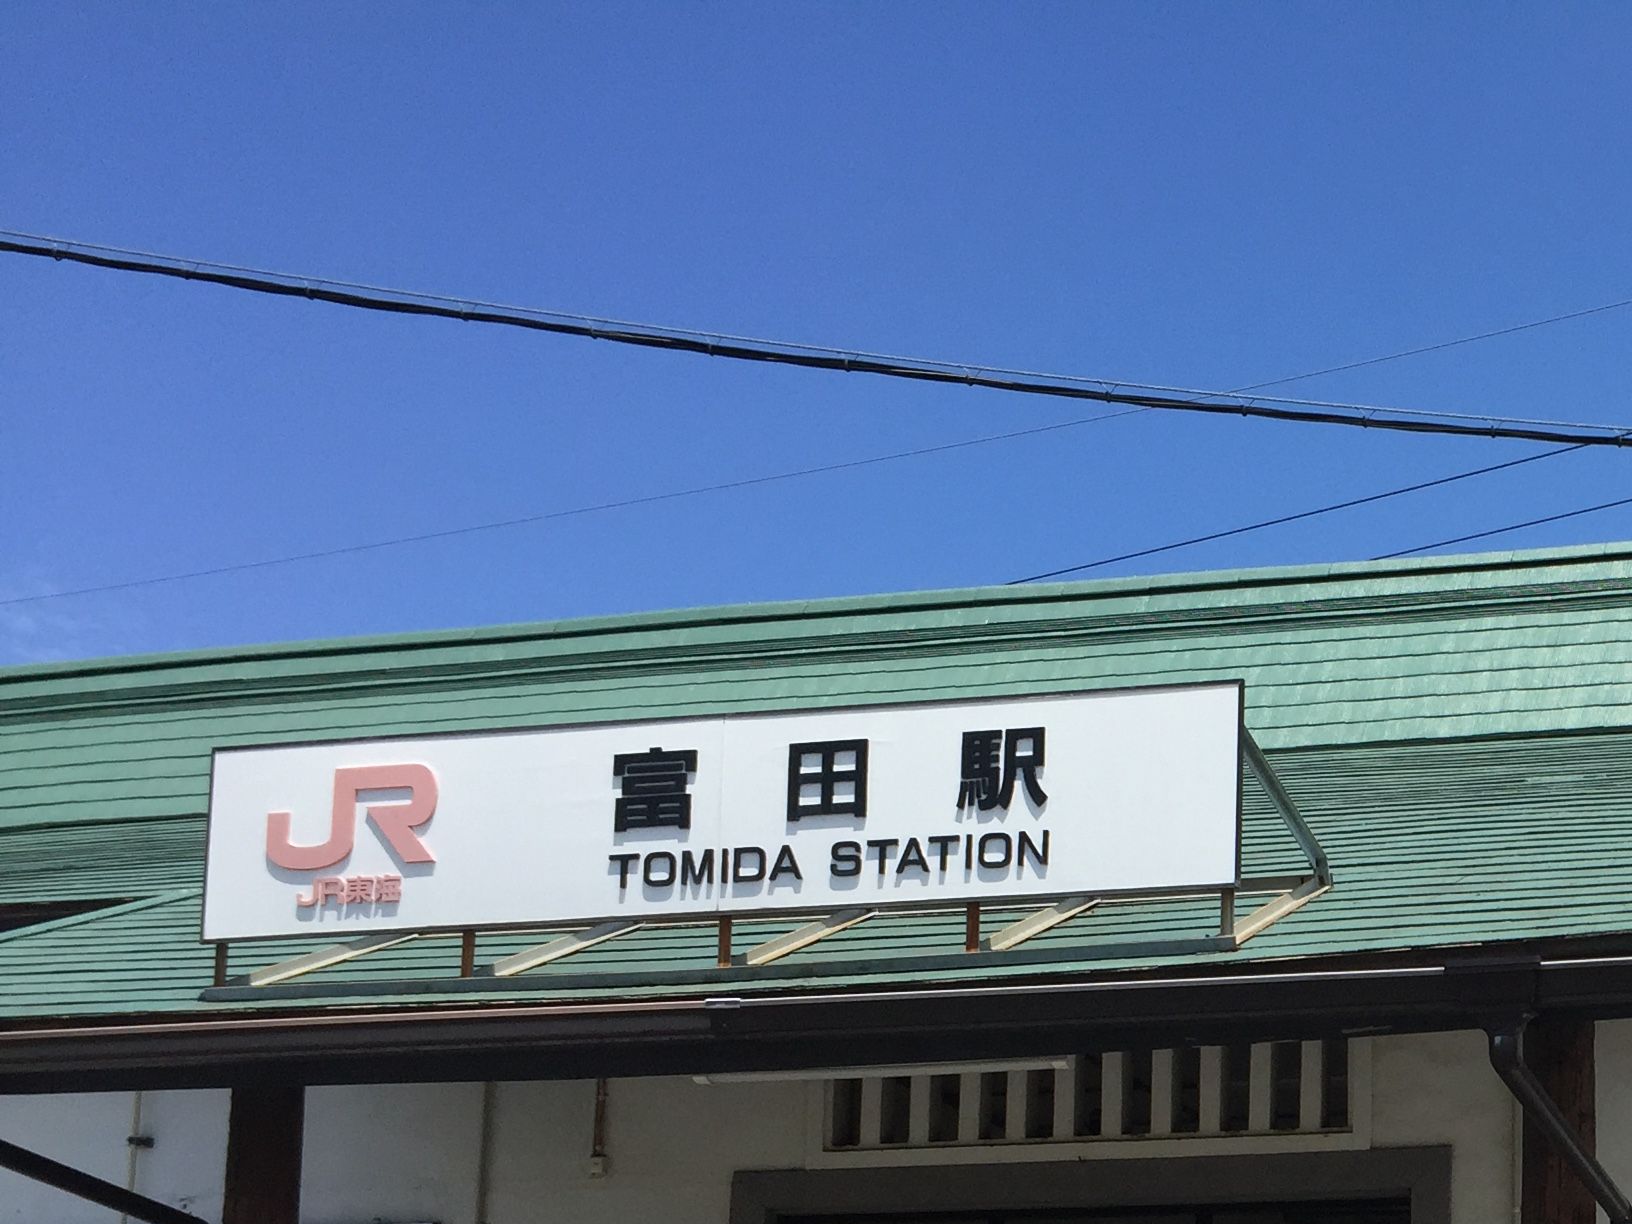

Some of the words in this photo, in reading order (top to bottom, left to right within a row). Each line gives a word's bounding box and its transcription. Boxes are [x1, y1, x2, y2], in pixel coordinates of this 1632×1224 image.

[266, 763, 439, 871] JR
[614, 727, 1048, 834] 富田駅
[296, 874, 402, 908] JR東海
[608, 844, 804, 890] TOMIDA
[830, 830, 1050, 878] STATION
